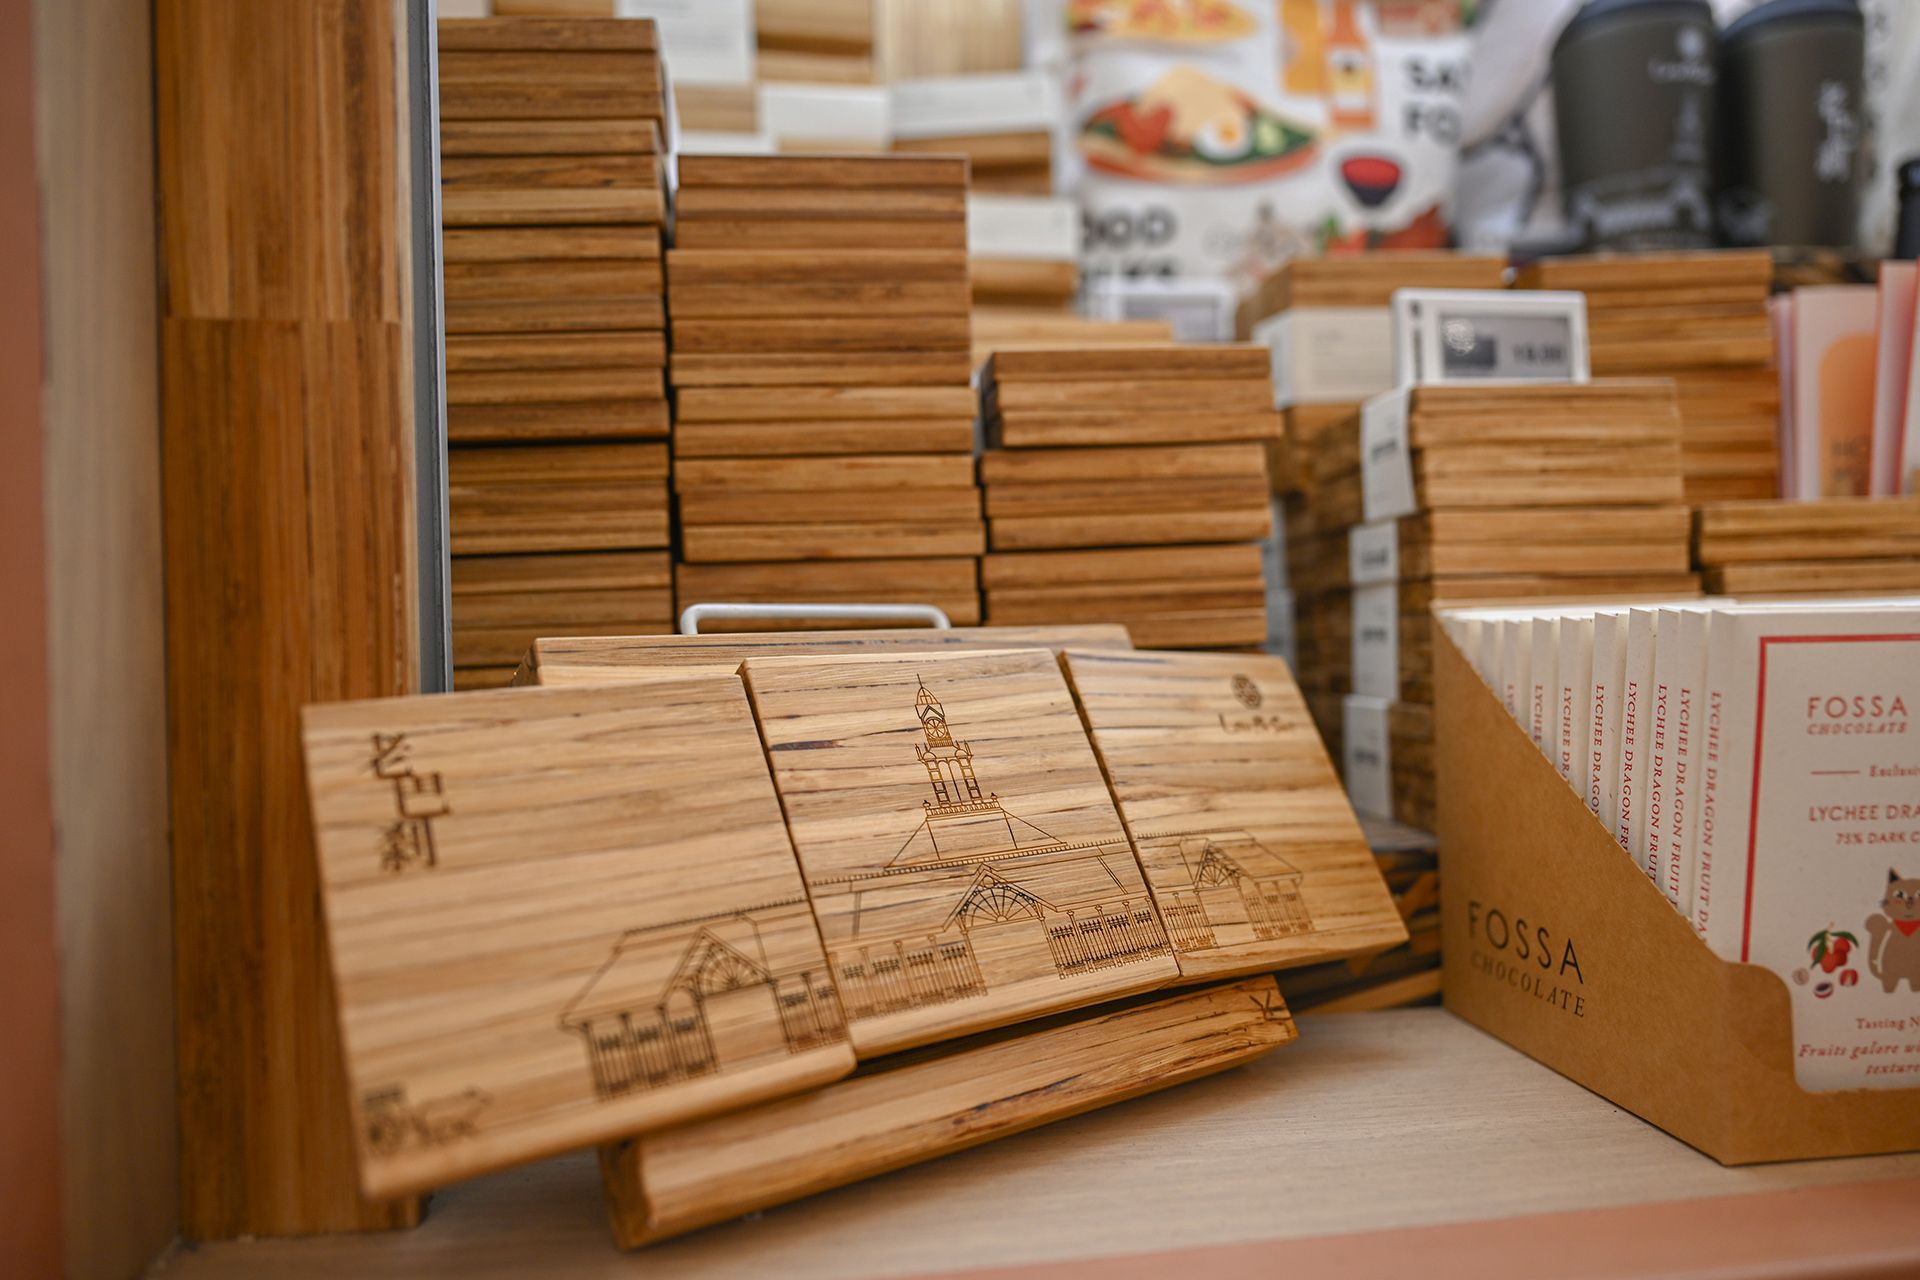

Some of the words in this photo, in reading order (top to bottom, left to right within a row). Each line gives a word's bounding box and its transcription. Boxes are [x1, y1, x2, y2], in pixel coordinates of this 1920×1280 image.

[1562, 687, 1572, 747] LYCHEE
[1594, 684, 1605, 746] LYCHEE
[1625, 681, 1638, 745] LYCHEE
[1655, 684, 1668, 750] LYCHEE
[1678, 688, 1691, 757] LYCHEE
[1706, 691, 1722, 762] LYCHEE
[1806, 695, 1909, 719] FOSSA
[1806, 722, 1908, 736] CHOCOLATE
[1561, 751, 1570, 778] DR
[1621, 750, 1634, 821] DRAGON
[1650, 755, 1664, 829] DRAGON
[1672, 761, 1687, 838] DRAGON
[1703, 767, 1718, 846] DRAGON
[1808, 804, 1879, 822] LYCHEE
[1648, 833, 1659, 882] FRUIT
[1669, 842, 1681, 895] FRUIT
[1867, 831, 1906, 845] DARK
[1700, 851, 1713, 907] FRUIT
[1467, 900, 1584, 985] FOSSA
[1469, 949, 1586, 1018] CHOCOLATE
[1799, 1043, 1847, 1057] Fruits
[1849, 1040, 1899, 1060] galore
[1856, 1017, 1906, 1032] Tasting
